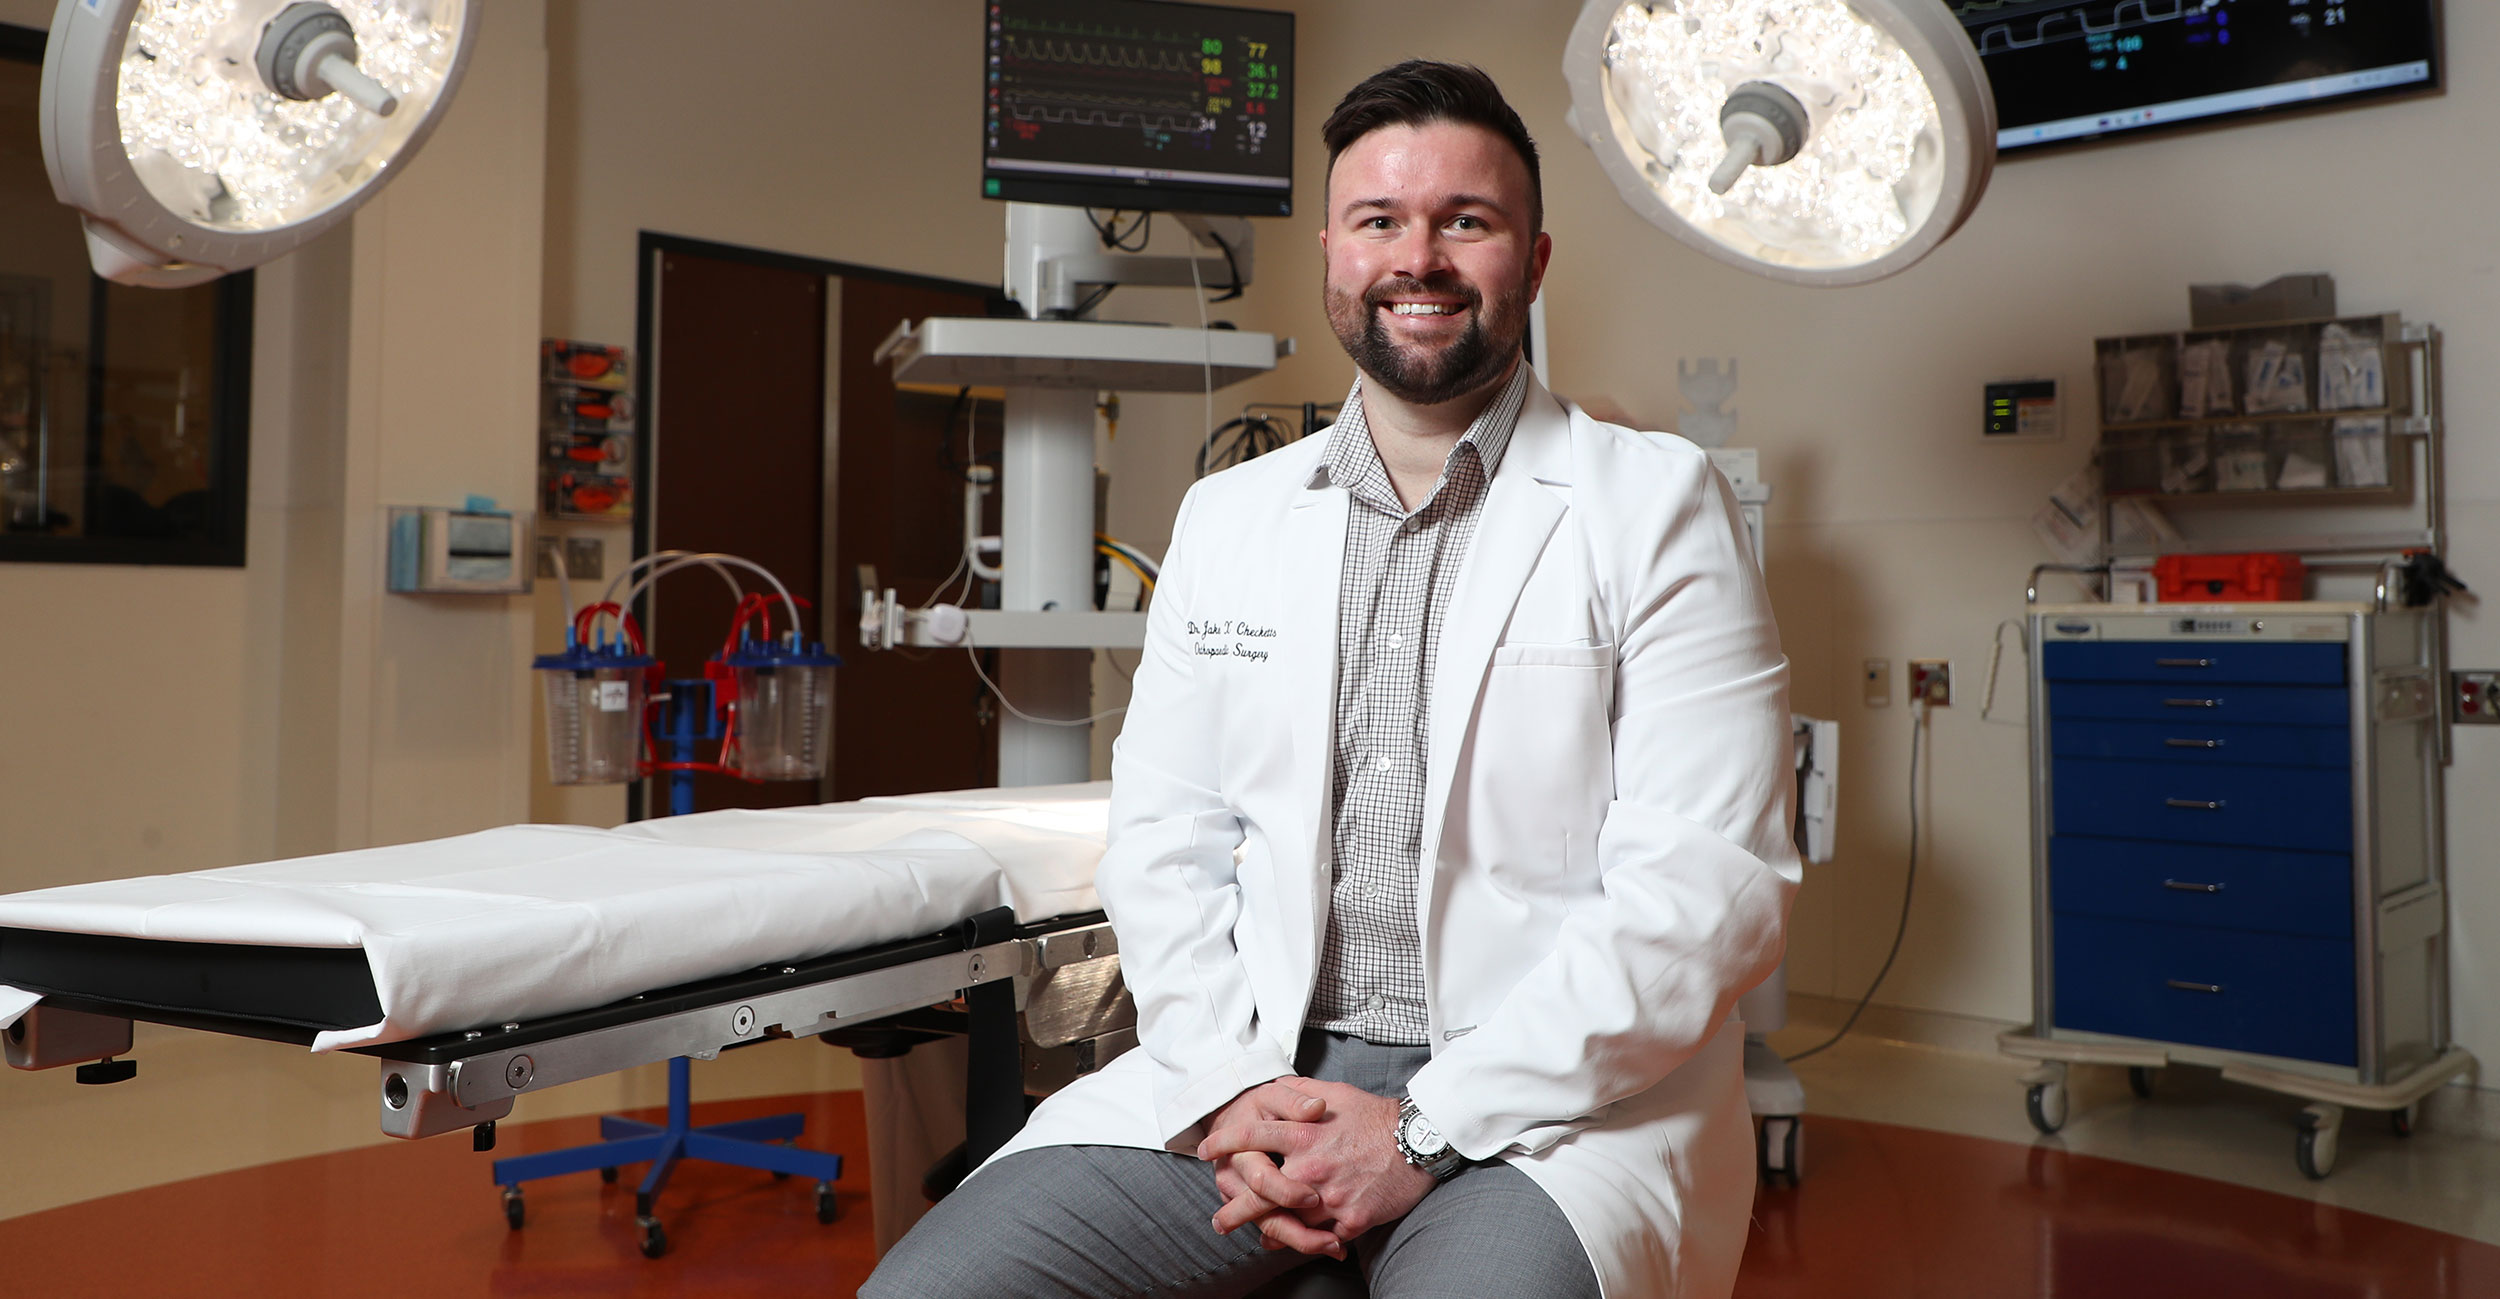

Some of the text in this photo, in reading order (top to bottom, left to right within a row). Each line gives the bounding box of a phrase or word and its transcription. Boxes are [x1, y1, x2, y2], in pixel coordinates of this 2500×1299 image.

[2323, 6, 2346, 27] 21
[1247, 42, 1269, 59] 77
[1247, 81, 1279, 100] 37.2
[1247, 121, 1268, 138] 12
[1232, 642, 1270, 663] Surgery
